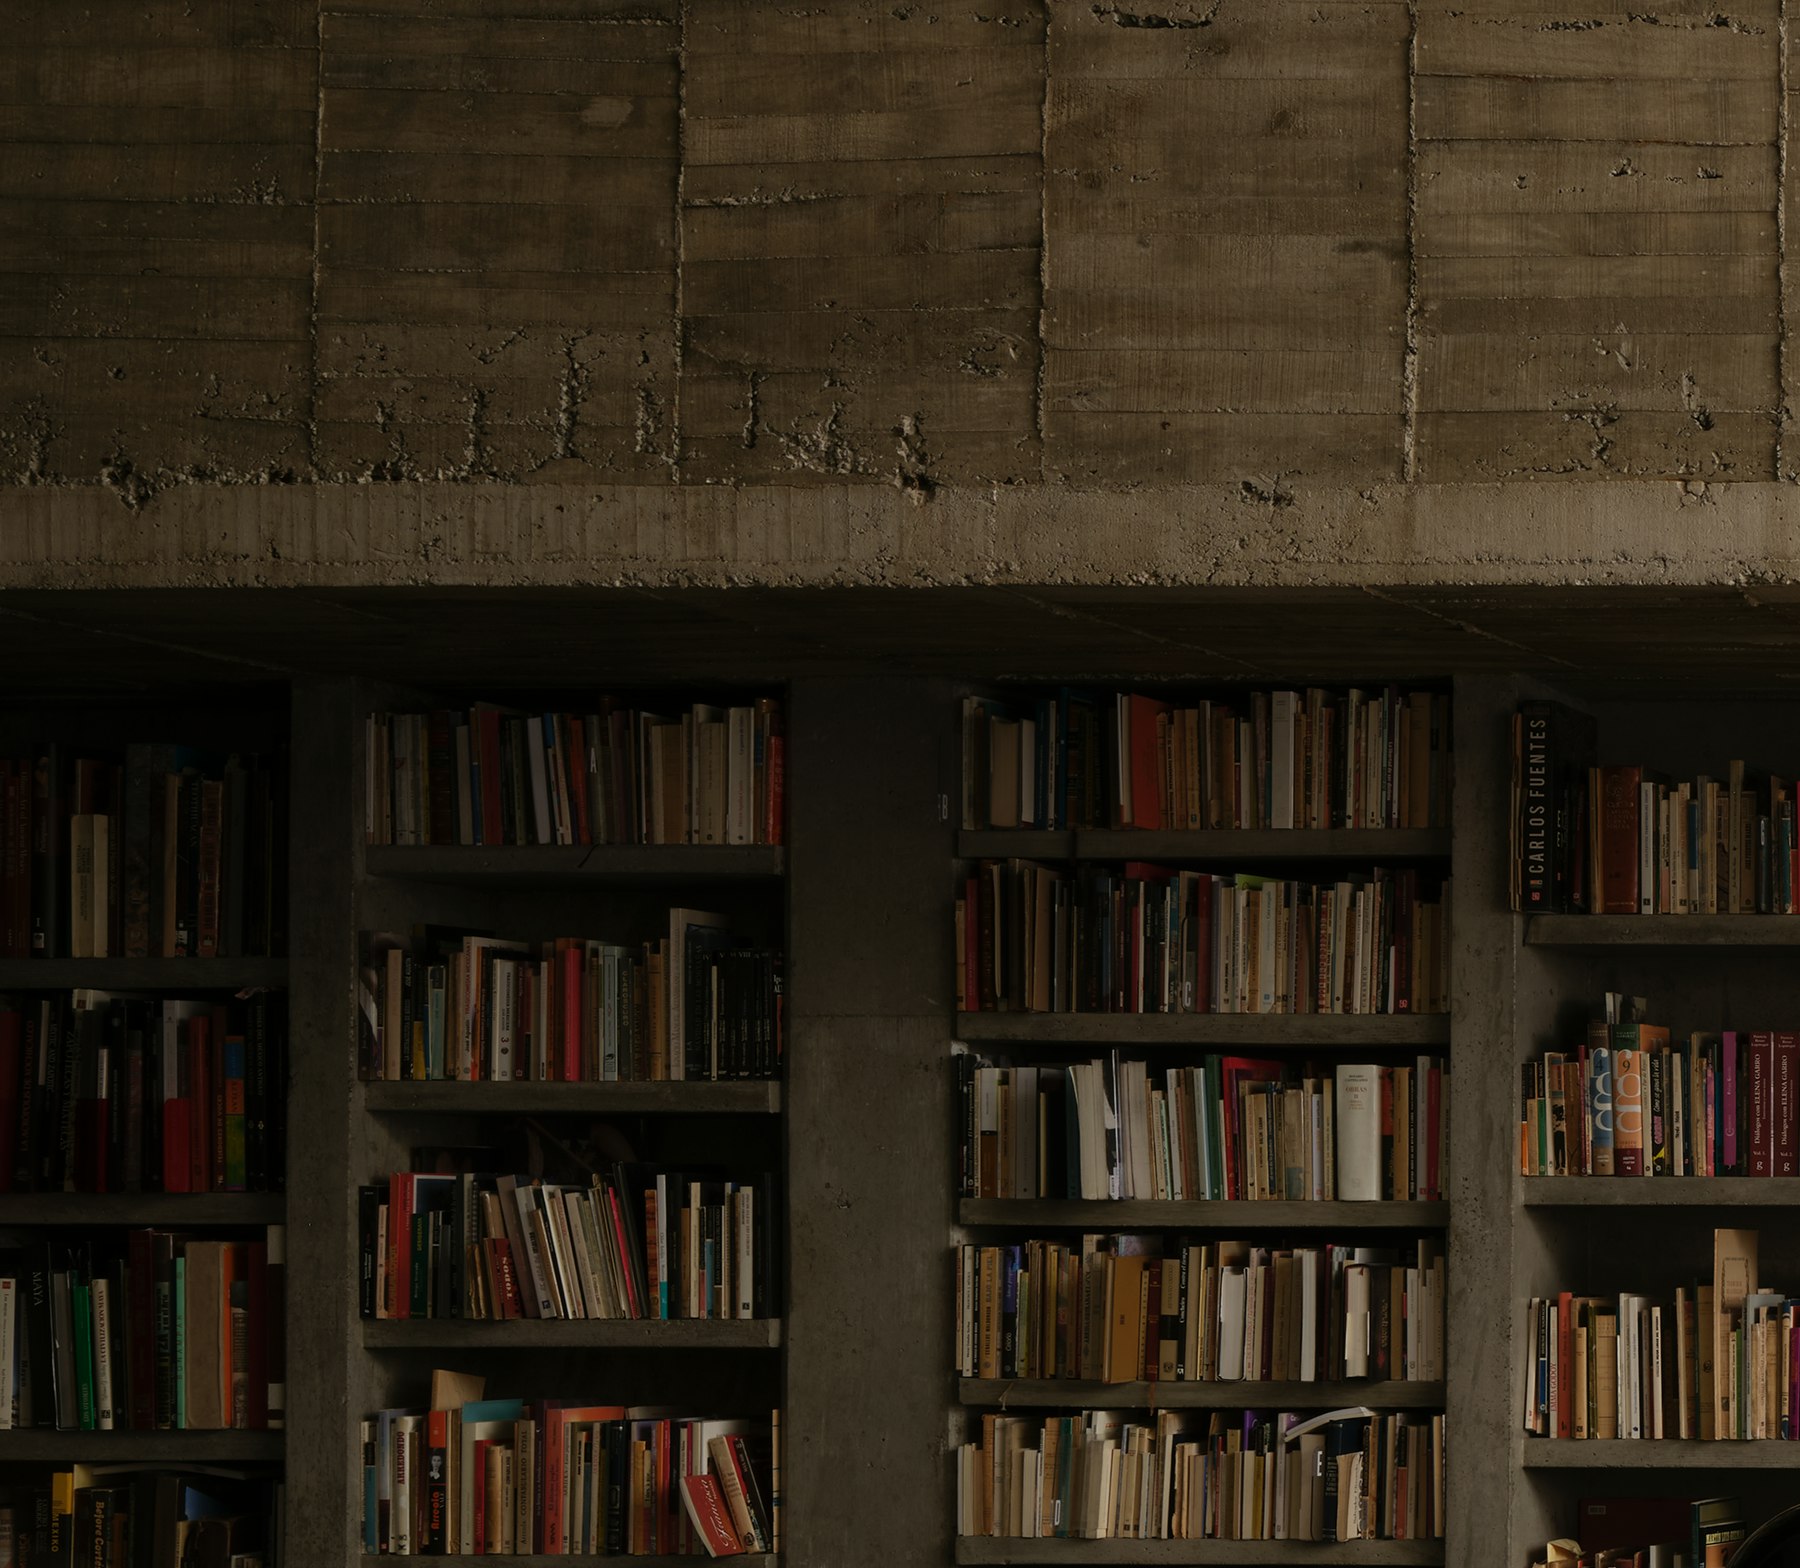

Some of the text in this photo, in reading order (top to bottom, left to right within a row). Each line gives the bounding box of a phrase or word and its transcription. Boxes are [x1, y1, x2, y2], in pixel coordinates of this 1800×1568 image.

[1529, 719, 1545, 873] CARLOS FUENTES
[1621, 1058, 1631, 1074] 9
[1754, 1119, 1762, 1144] Diálogos
[1781, 1120, 1789, 1145] Diálogos
[33, 1272, 43, 1305] MAYA
[501, 1256, 513, 1299] TODOS
[1550, 1363, 1558, 1411] EMMA GODOY
[397, 1431, 405, 1484] ARREDONDO
[51, 1513, 60, 1552] MEXIKO
[94, 1501, 105, 1535] Before
